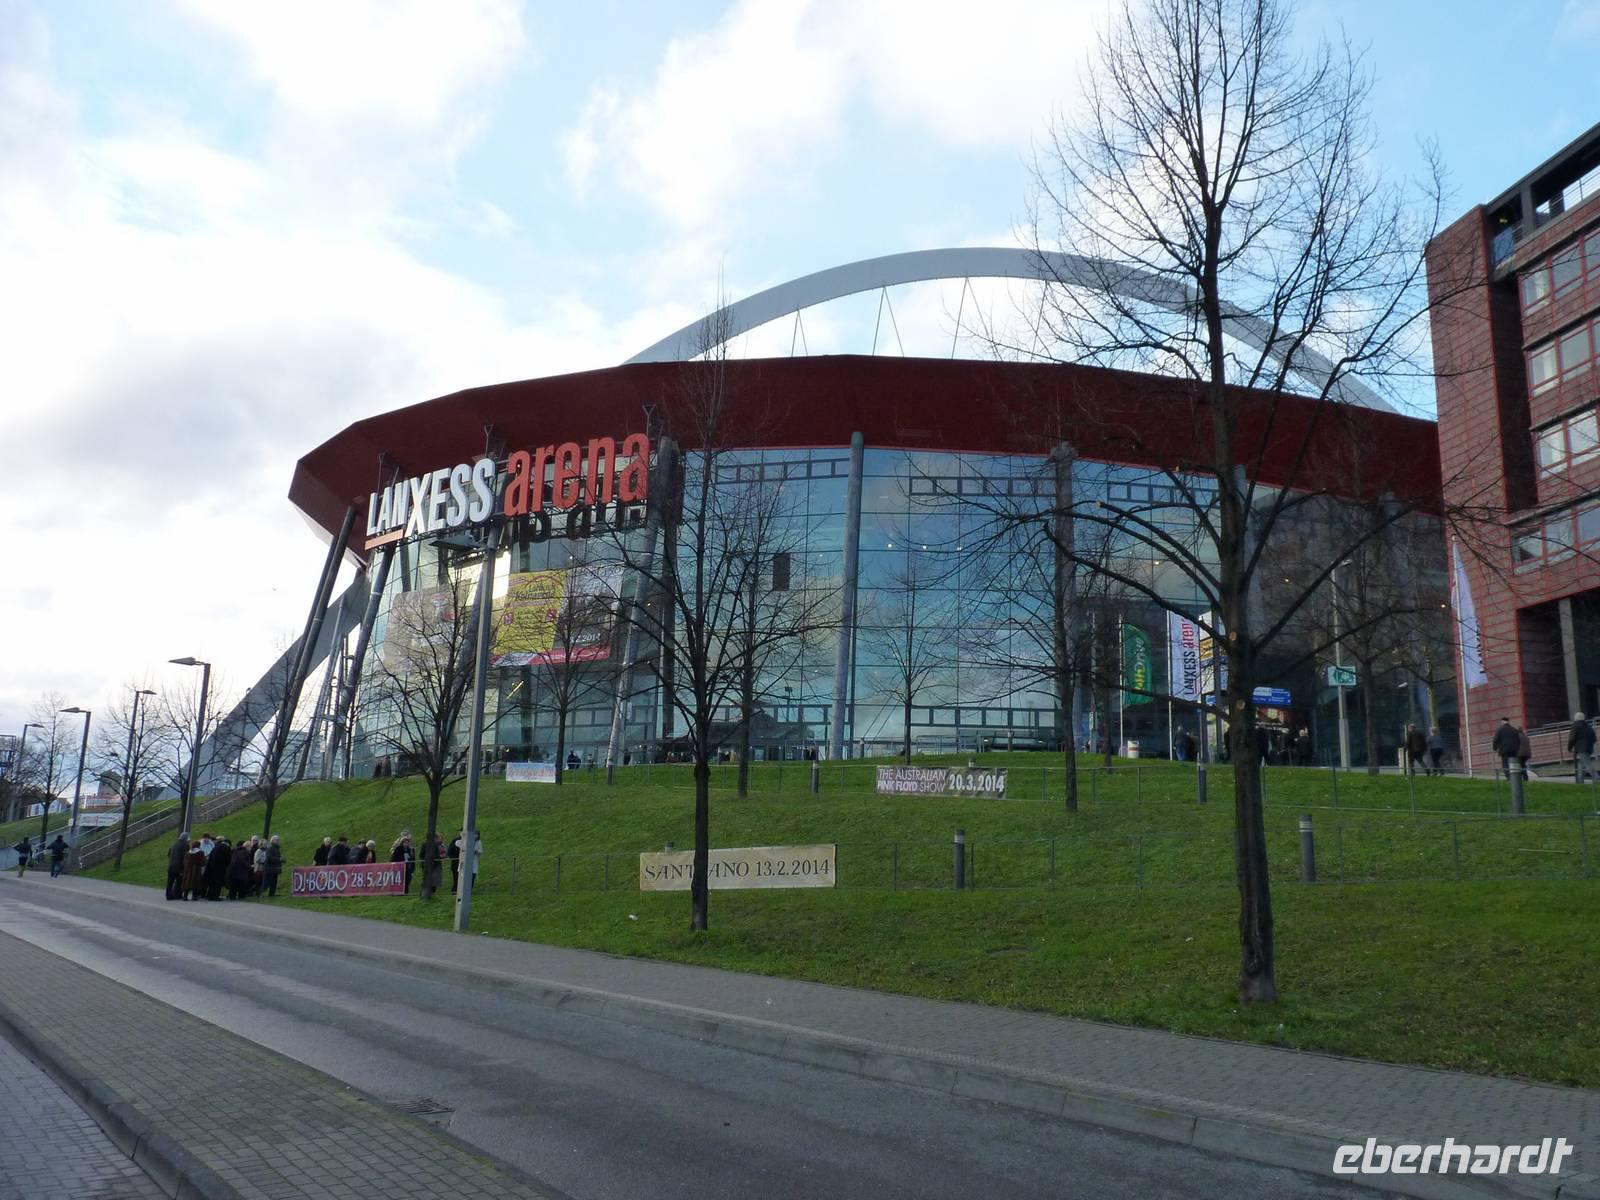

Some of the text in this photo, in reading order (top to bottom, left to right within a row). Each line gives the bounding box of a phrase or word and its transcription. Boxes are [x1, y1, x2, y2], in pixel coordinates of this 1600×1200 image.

[366, 433, 650, 537] LANXESS arena
[1183, 651, 1197, 695] LANXESS
[879, 768, 947, 781] THE AUSTRALIAN
[948, 774, 1005, 793] 20.3.2014
[877, 781, 946, 793] PINK FLOYD SHOW
[351, 870, 401, 888] 28.5.2014
[644, 859, 831, 881] SANTANO 13.2.2014
